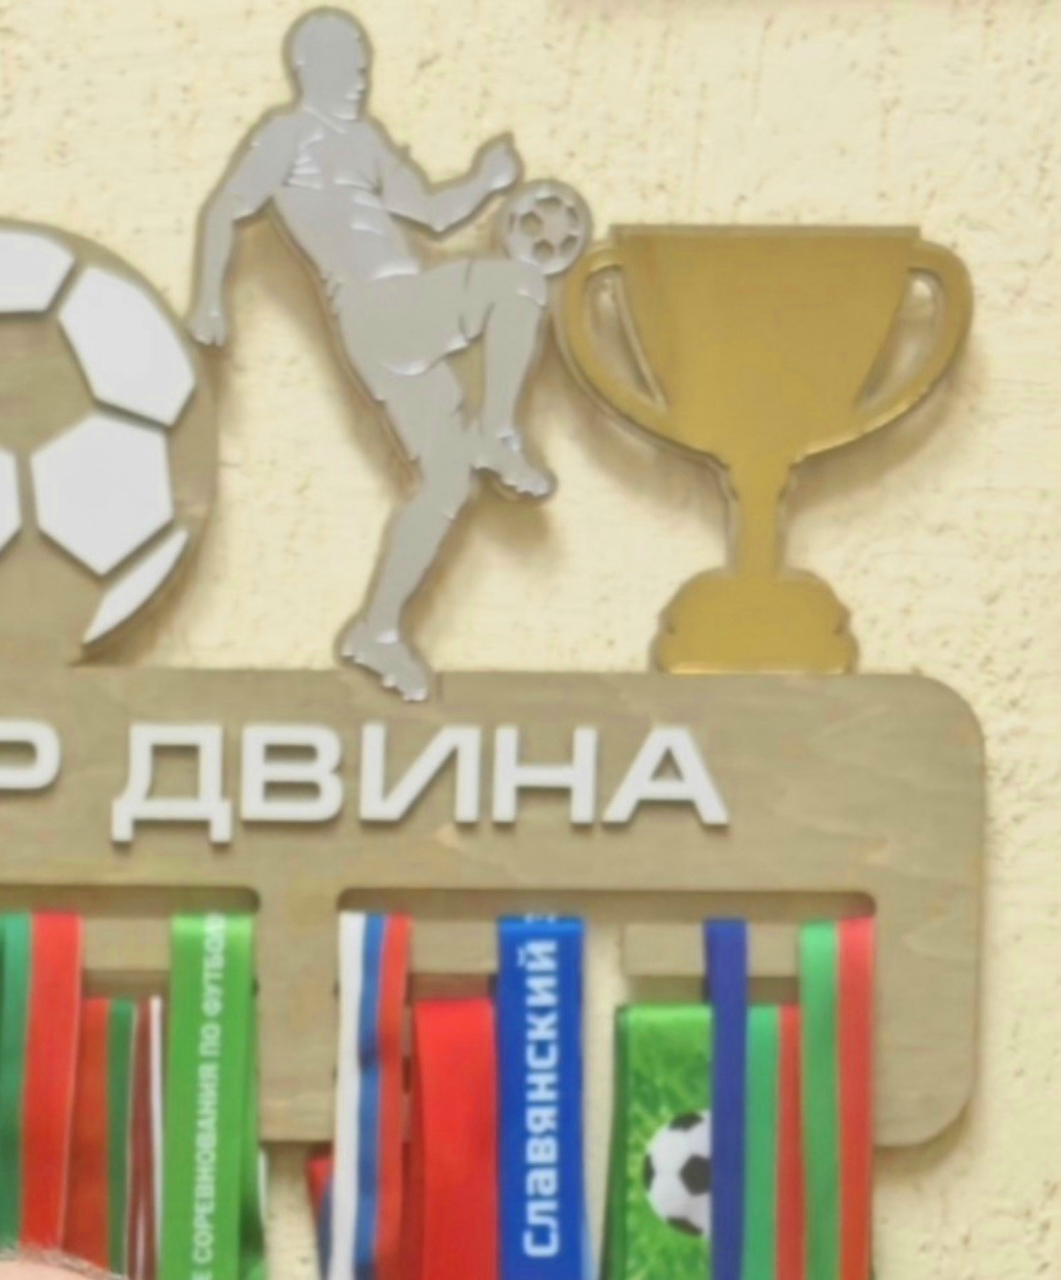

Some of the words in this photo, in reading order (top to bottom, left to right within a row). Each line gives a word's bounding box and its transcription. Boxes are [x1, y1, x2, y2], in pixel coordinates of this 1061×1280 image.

[111, 723, 729, 844] ДВИНА
[198, 1024, 223, 1057] ПО
[192, 1063, 221, 1265] СОРЕВНОВАНИЯ
